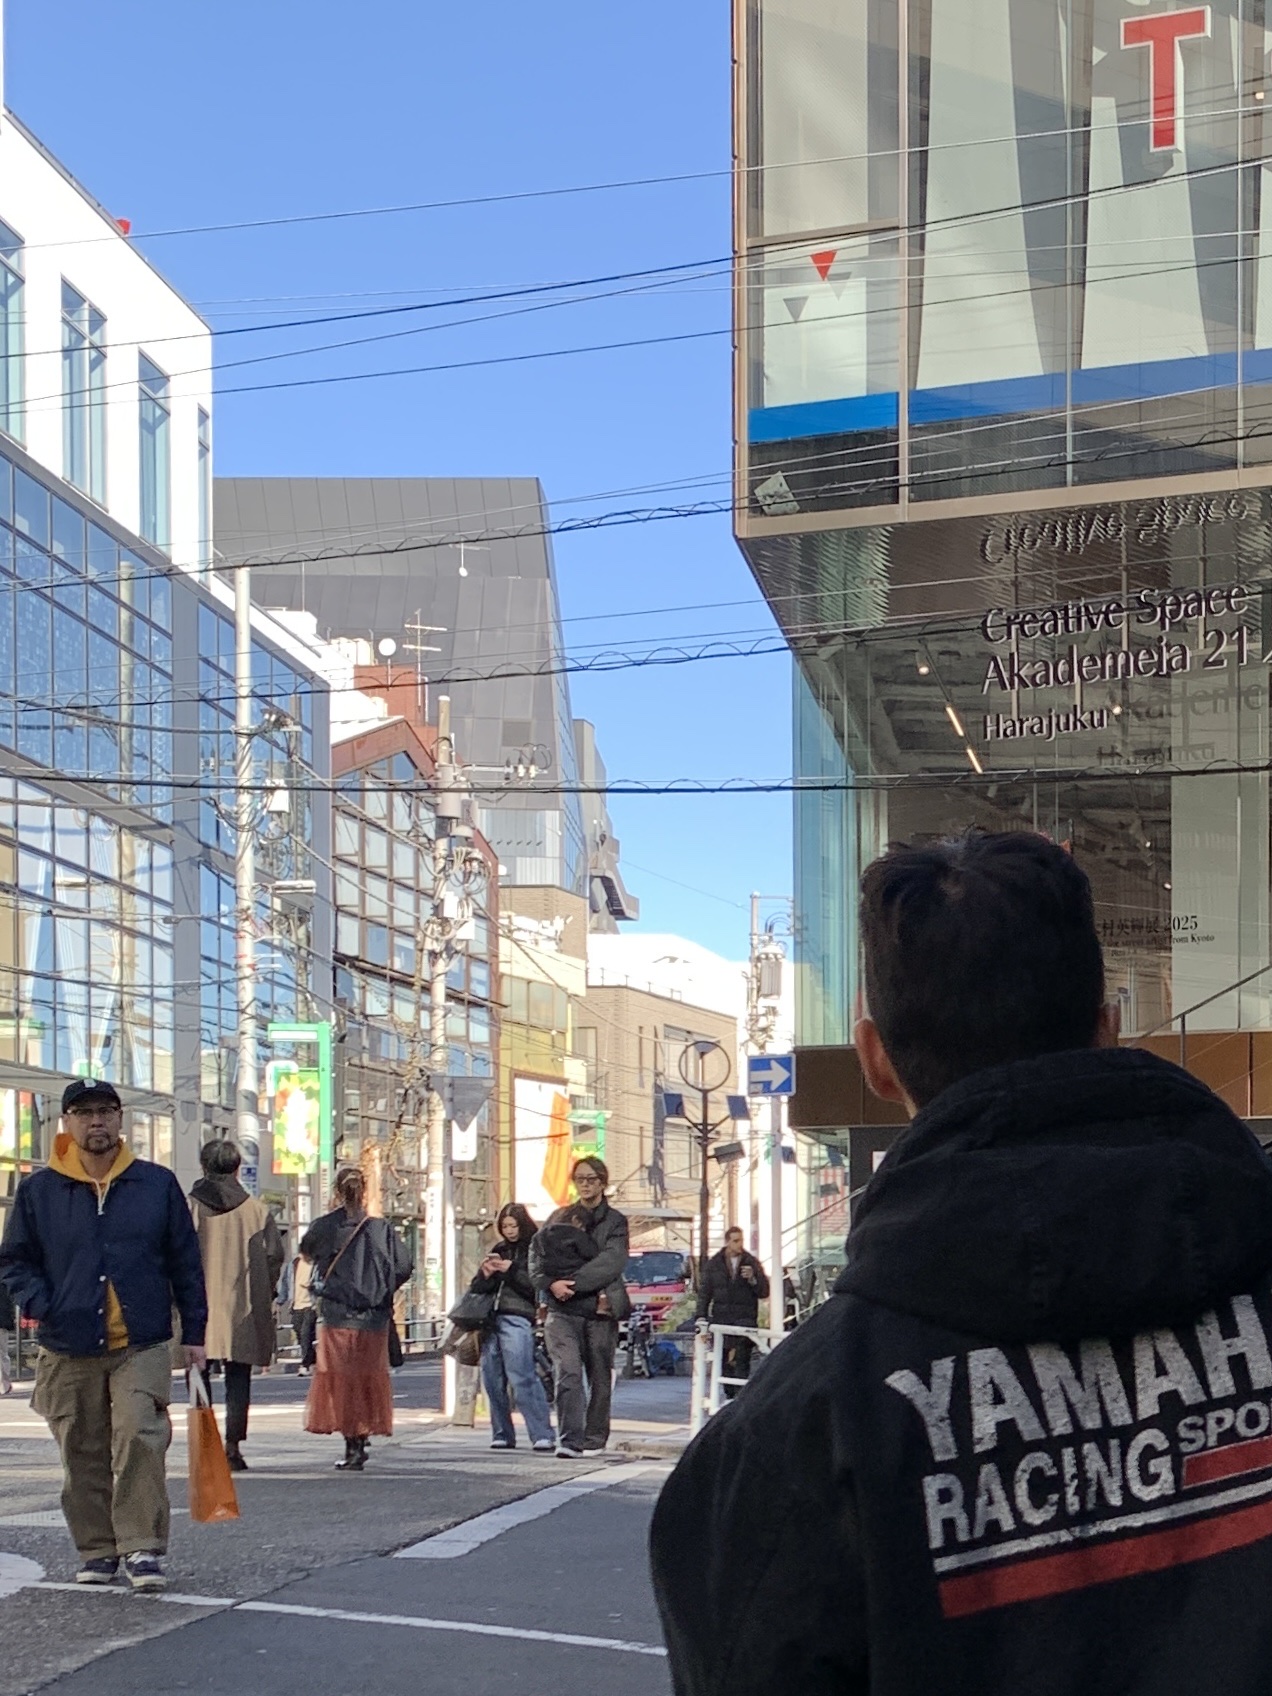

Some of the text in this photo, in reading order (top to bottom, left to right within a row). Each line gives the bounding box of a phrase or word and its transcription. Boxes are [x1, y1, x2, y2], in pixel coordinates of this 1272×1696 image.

[981, 585, 1249, 643] Creative Space
[982, 625, 1248, 695] Akademeia 21
[983, 704, 1109, 741] Harajuku
[922, 1428, 1176, 1550] RACING
